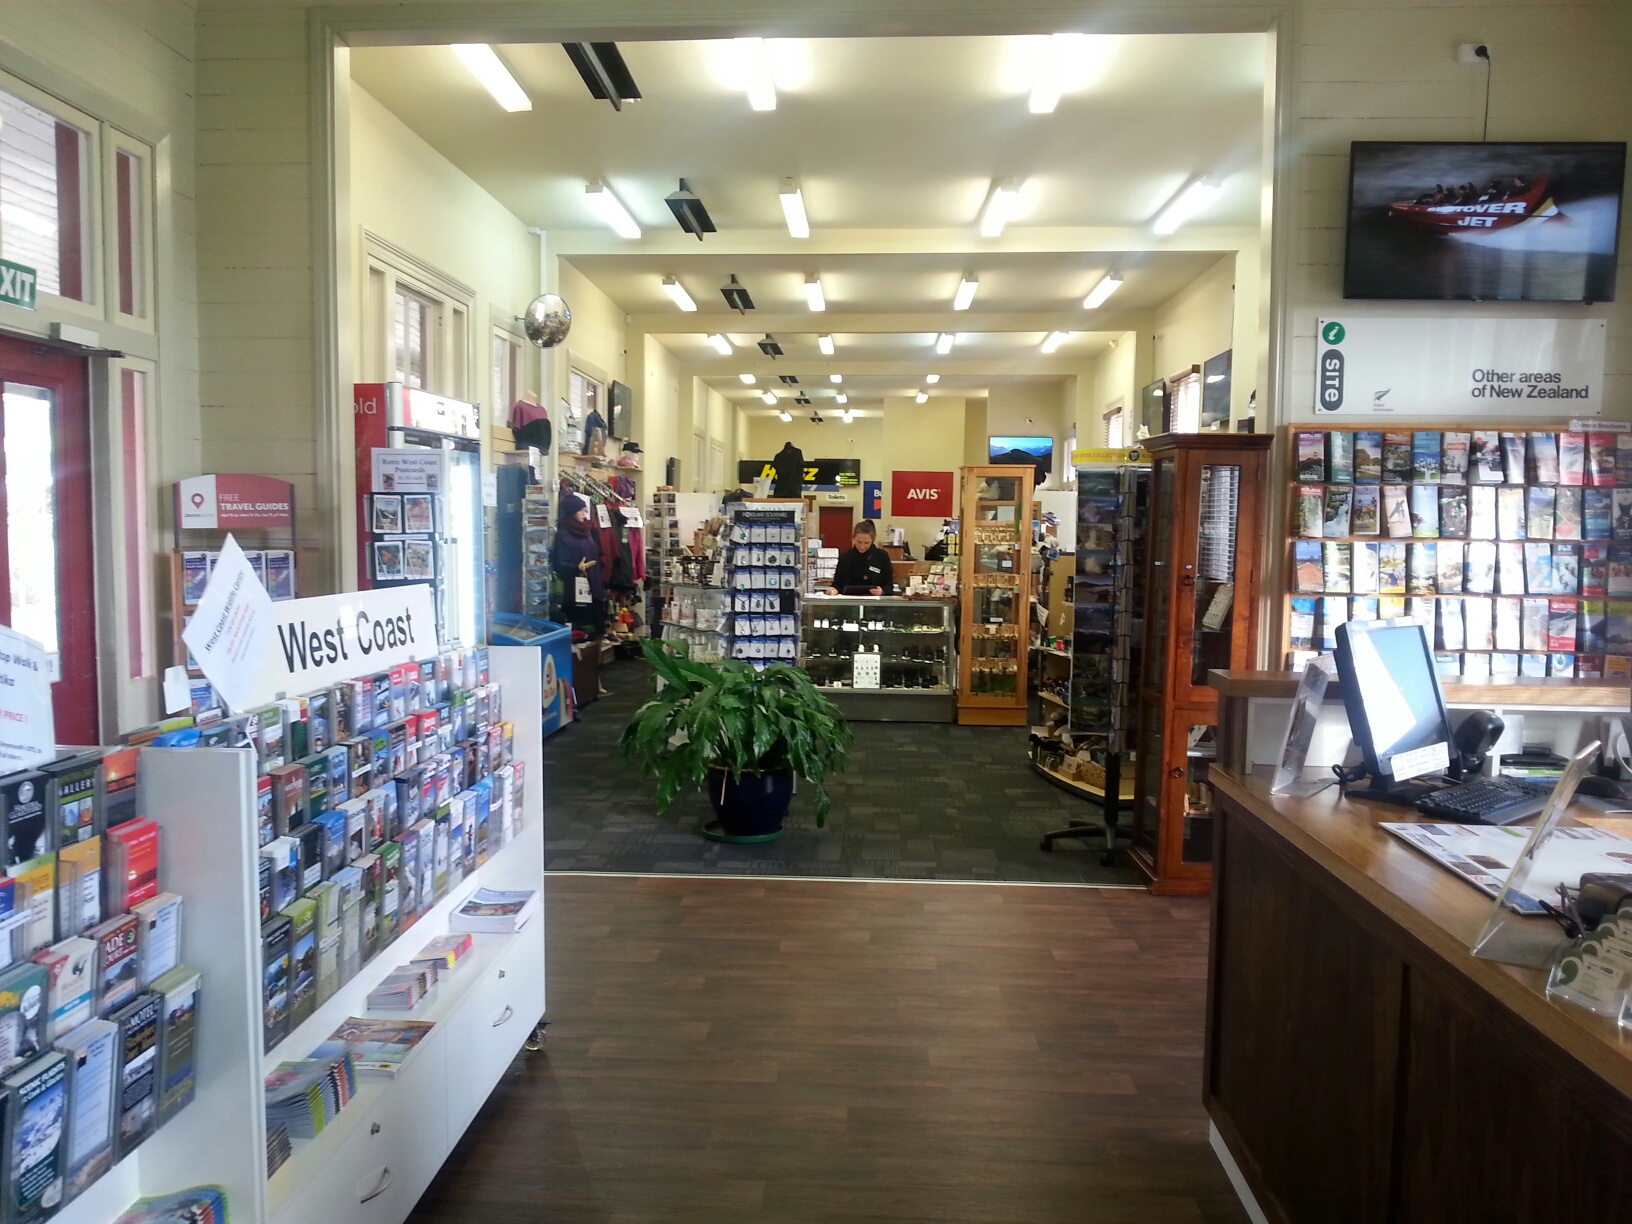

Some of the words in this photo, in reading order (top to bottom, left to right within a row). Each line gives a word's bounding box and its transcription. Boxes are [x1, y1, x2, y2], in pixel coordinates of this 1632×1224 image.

[1457, 216, 1498, 227] JET
[0, 265, 35, 302] XIT
[1472, 368, 1516, 383] Other
[1519, 372, 1562, 384] areas
[1471, 384, 1487, 398] of
[1489, 384, 1524, 398] New
[1526, 384, 1589, 399] Zealand
[219, 493, 240, 502] FREE
[906, 488, 939, 500] AVIS
[220, 503, 254, 511] TRAVEL
[255, 502, 289, 511] GUIDES
[276, 618, 349, 674] West
[356, 606, 415, 655] Coast
[106, 932, 125, 953] ADE
